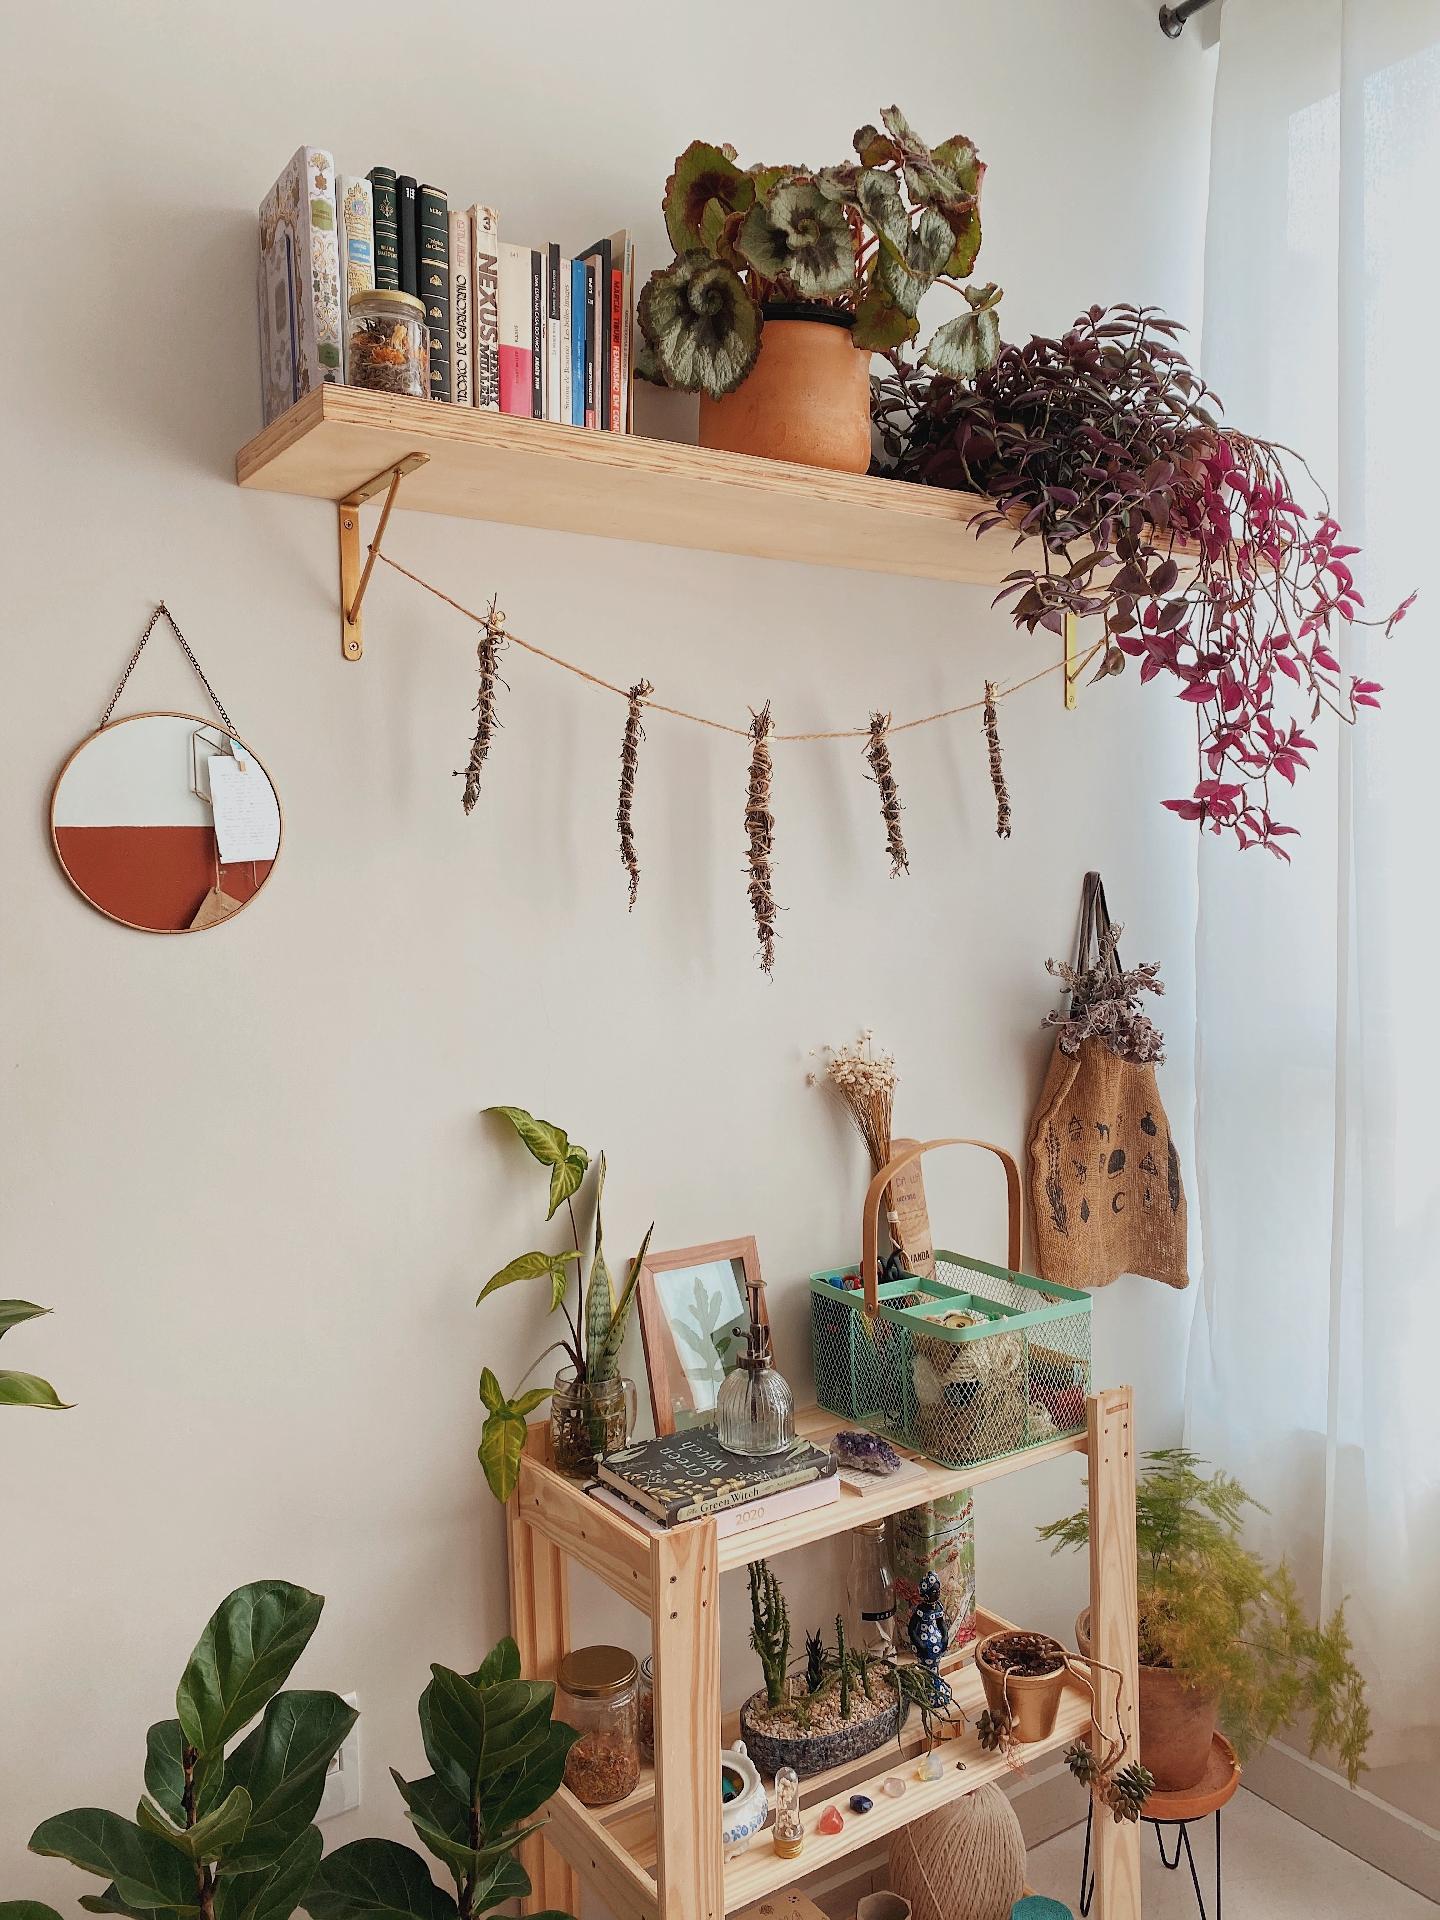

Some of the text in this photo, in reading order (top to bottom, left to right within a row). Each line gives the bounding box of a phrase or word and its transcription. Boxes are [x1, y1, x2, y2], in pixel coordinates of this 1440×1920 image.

[482, 216, 492, 231] 3
[477, 252, 499, 344] NEXUS
[479, 343, 490, 407] MILLER
[488, 348, 499, 406] HENRY
[612, 345, 620, 392] FEMINISMO
[612, 394, 620, 408] EM
[659, 1447, 708, 1478] Green
[678, 1440, 729, 1472] Witch
[700, 1494, 730, 1514] Green
[729, 1486, 760, 1502] Witch
[735, 1506, 766, 1526] 2020
